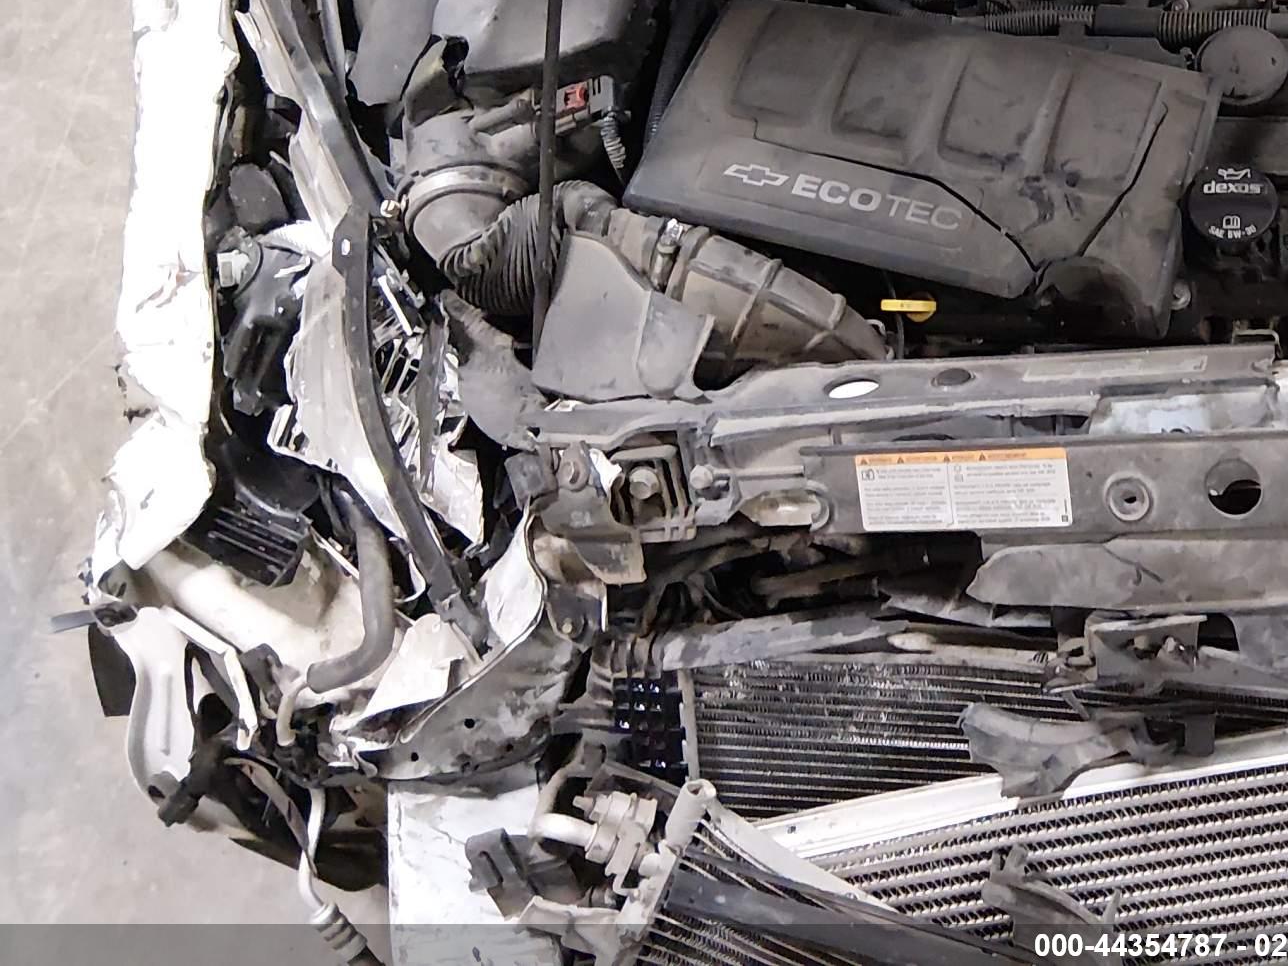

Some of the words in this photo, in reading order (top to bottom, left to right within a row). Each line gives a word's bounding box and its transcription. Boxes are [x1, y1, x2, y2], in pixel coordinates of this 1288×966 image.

[1203, 179, 1261, 194] dexos
[791, 173, 963, 230] ECOTEC
[1208, 225, 1225, 239] SAE
